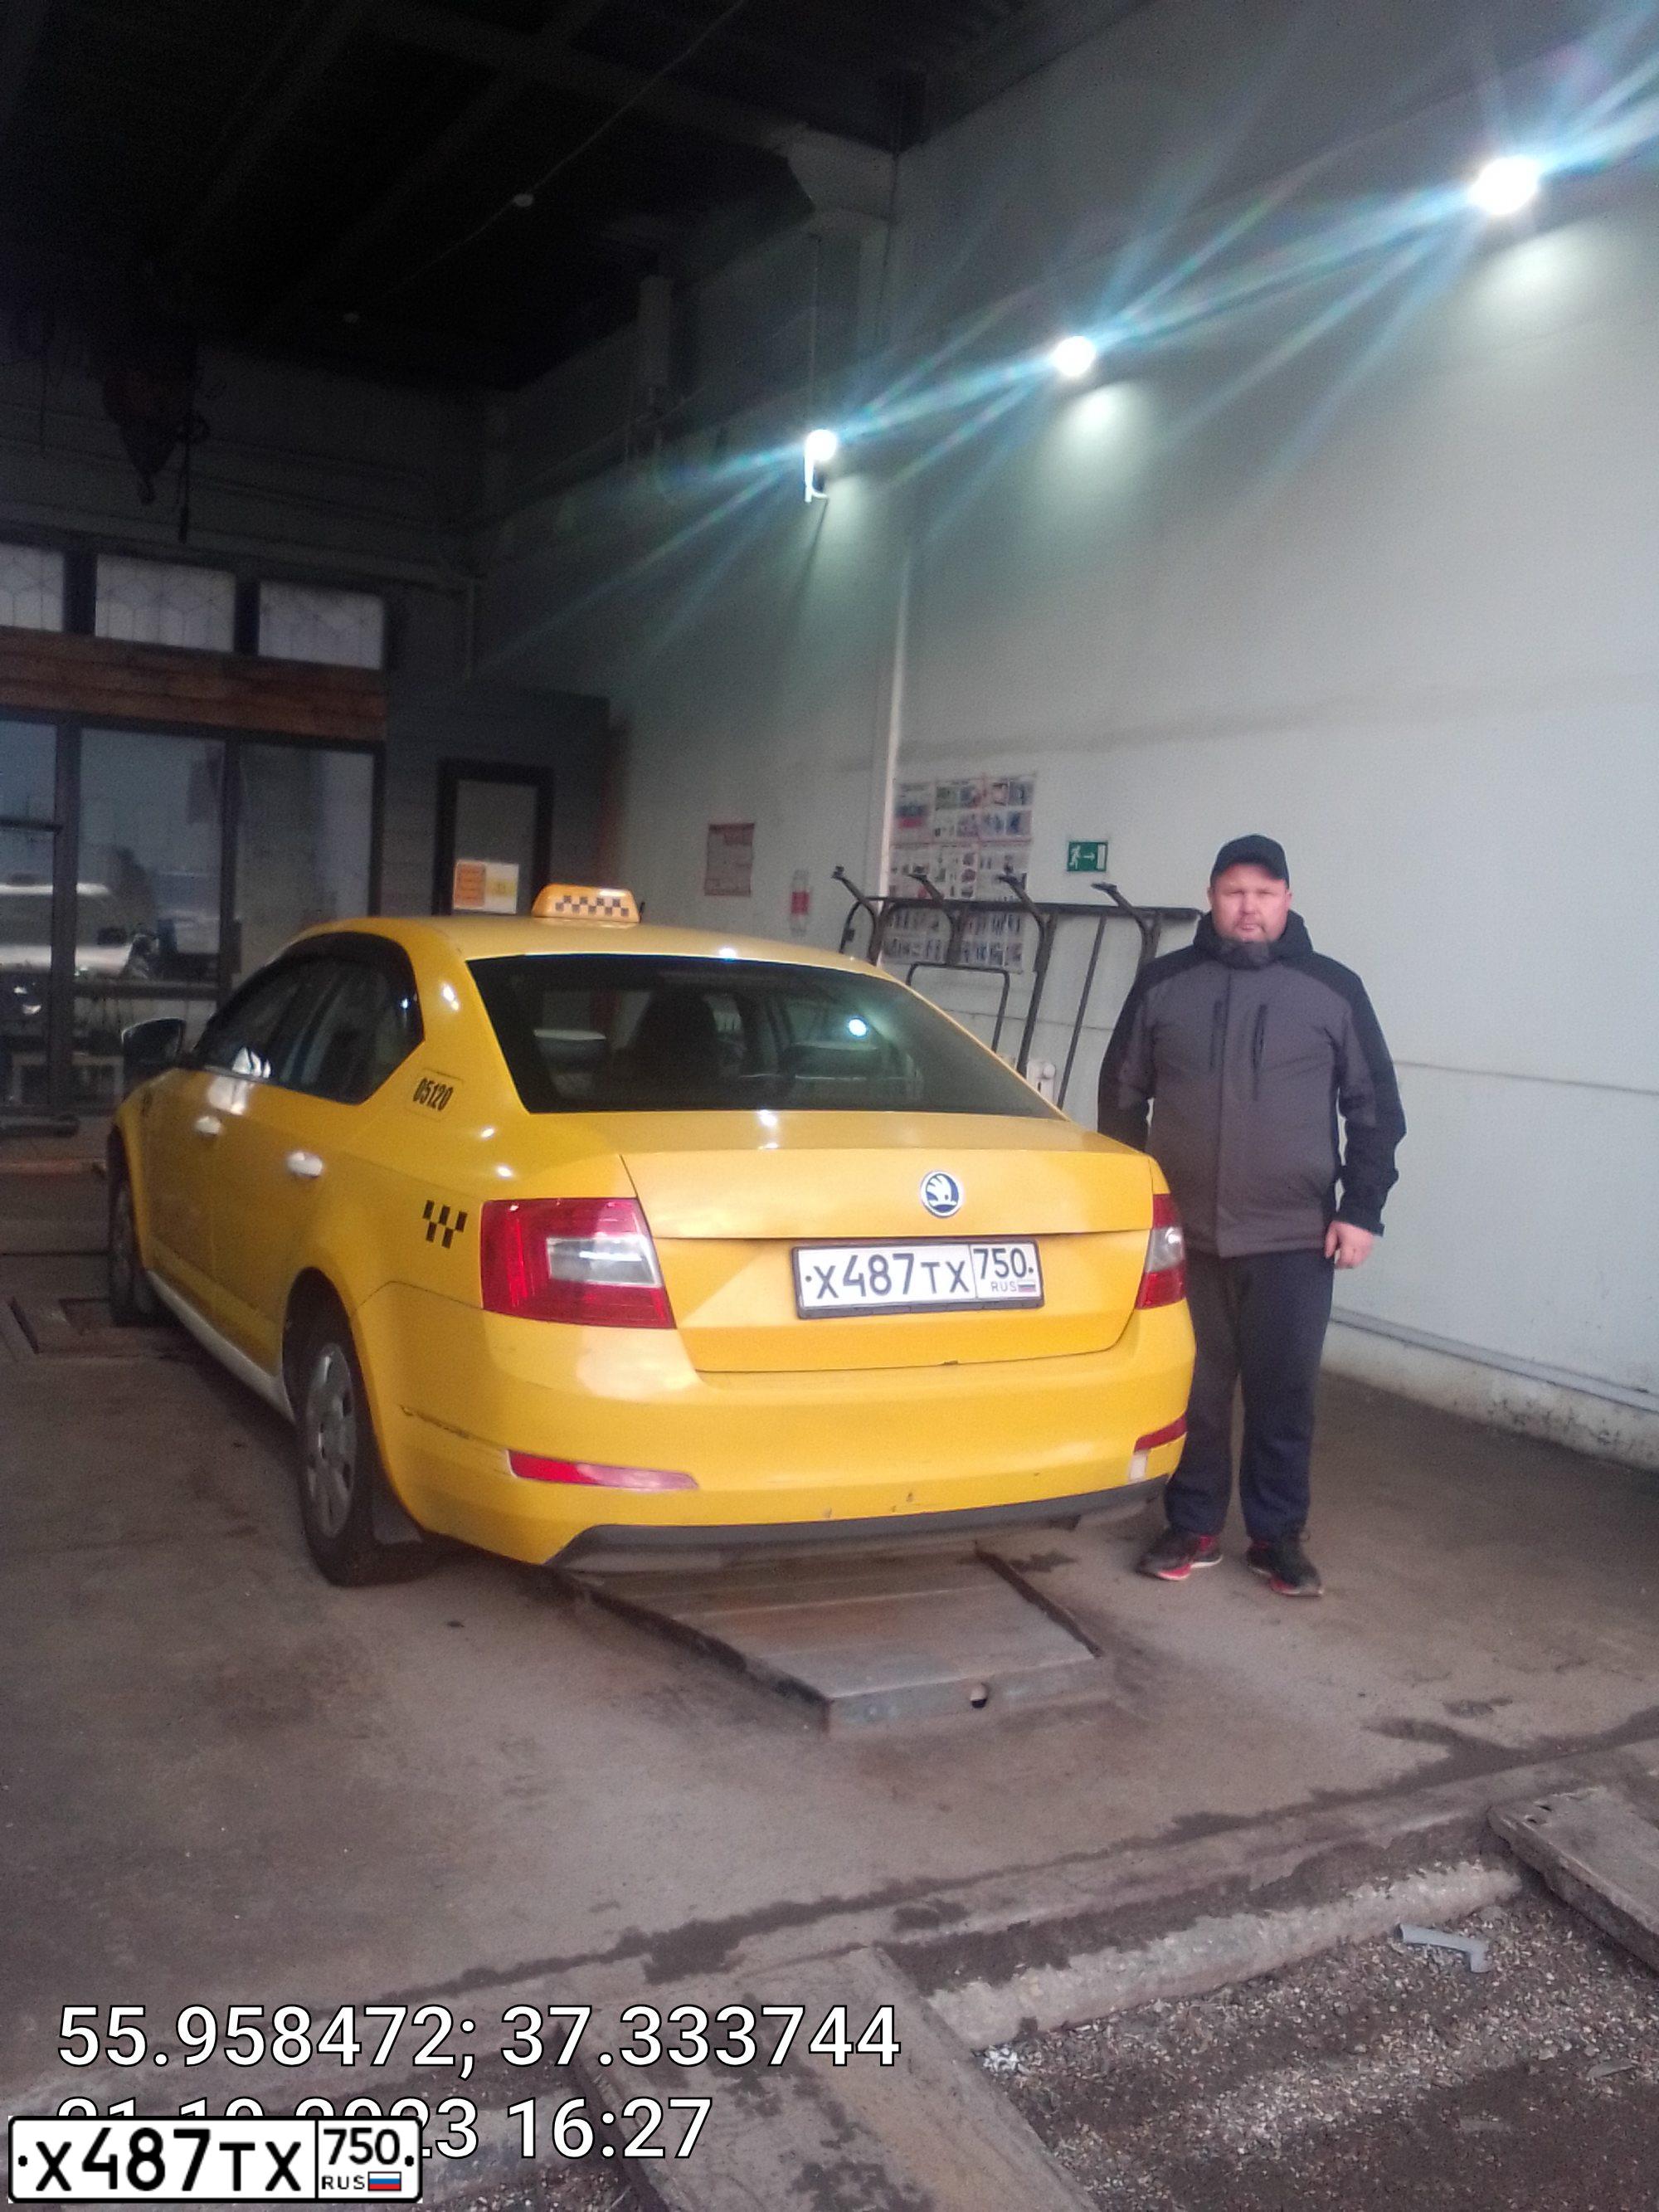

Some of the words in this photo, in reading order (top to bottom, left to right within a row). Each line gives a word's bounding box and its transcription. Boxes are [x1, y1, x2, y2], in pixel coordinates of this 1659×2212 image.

[413, 1077, 454, 1111] 05120
[973, 1248, 1028, 1279] 750
[991, 1281, 1017, 1293] RUS
